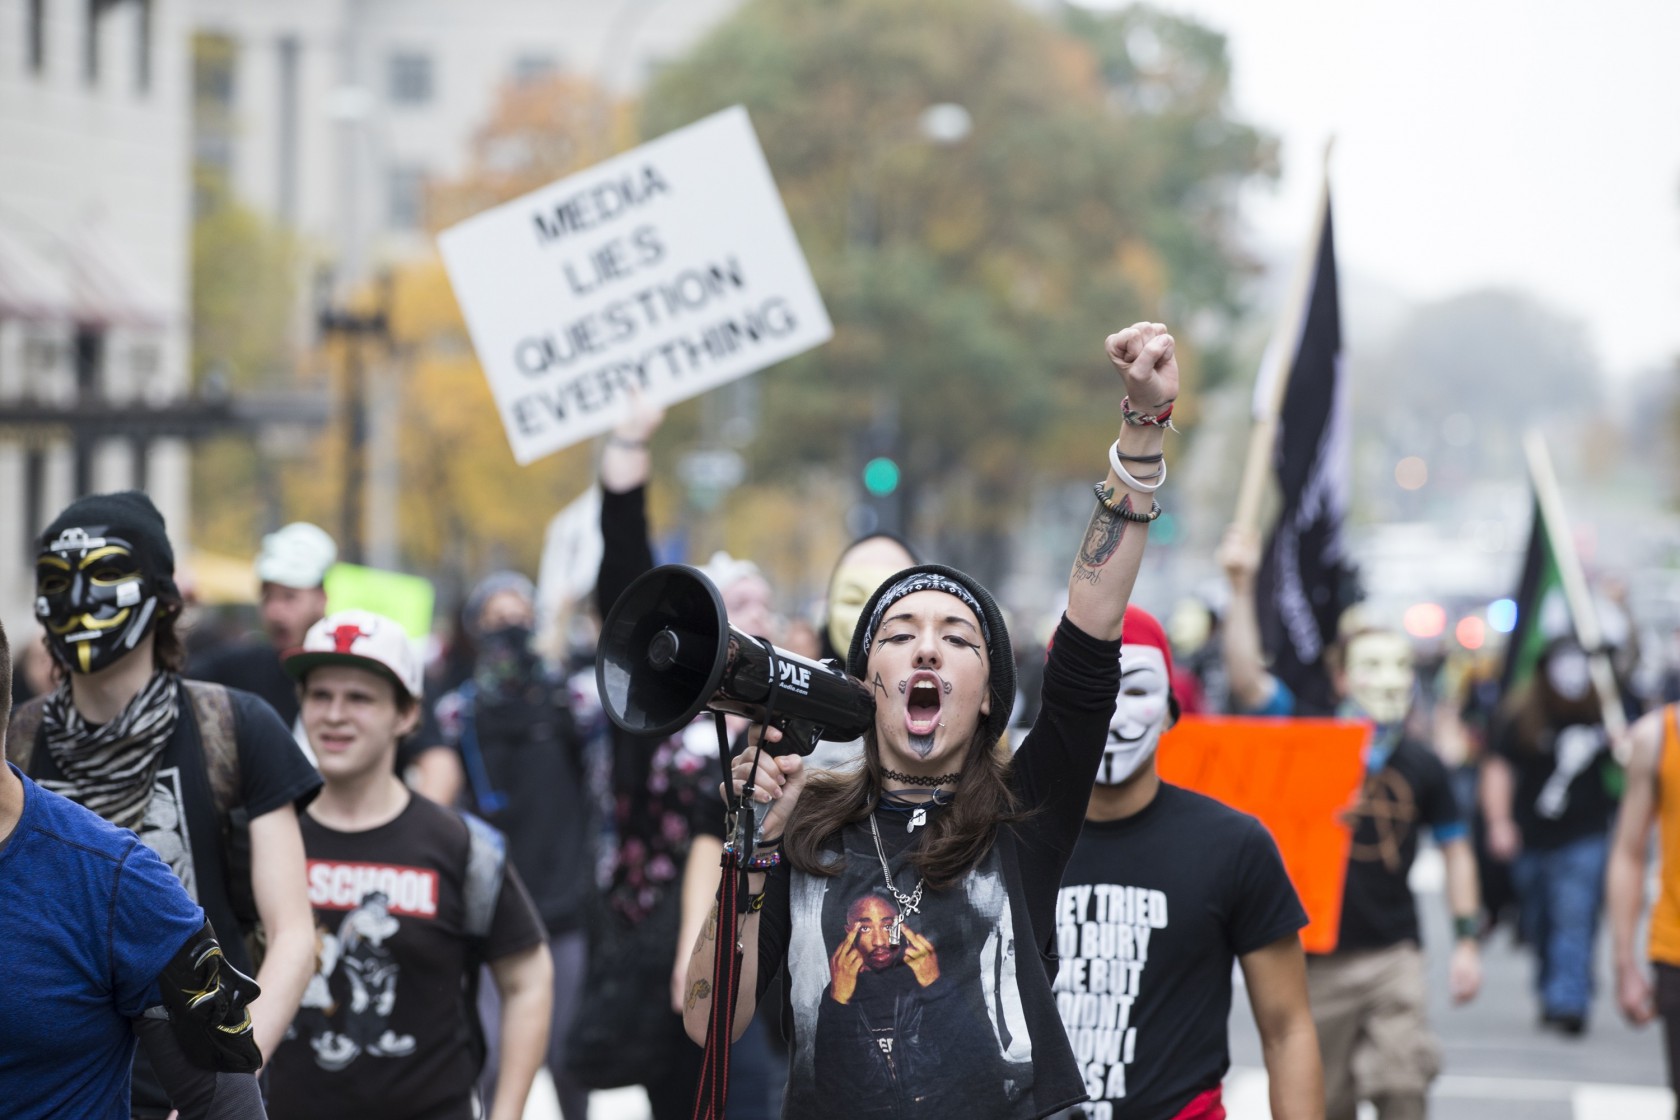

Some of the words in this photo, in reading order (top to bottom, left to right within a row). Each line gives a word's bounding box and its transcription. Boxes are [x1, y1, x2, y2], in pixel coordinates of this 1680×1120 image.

[532, 162, 669, 243] MEDIA
[564, 224, 666, 295] LIES
[514, 254, 745, 378] QUESTION
[512, 298, 798, 437] EVERYTHING
[308, 863, 437, 915] SCHOOL
[1056, 885, 1093, 925] EY
[1094, 883, 1168, 929] TRIED
[1056, 922, 1079, 959] O
[1081, 921, 1151, 962] BURY
[1089, 959, 1145, 997] BUT
[1077, 1061, 1105, 1100] S
[1105, 1061, 1126, 1099] A
